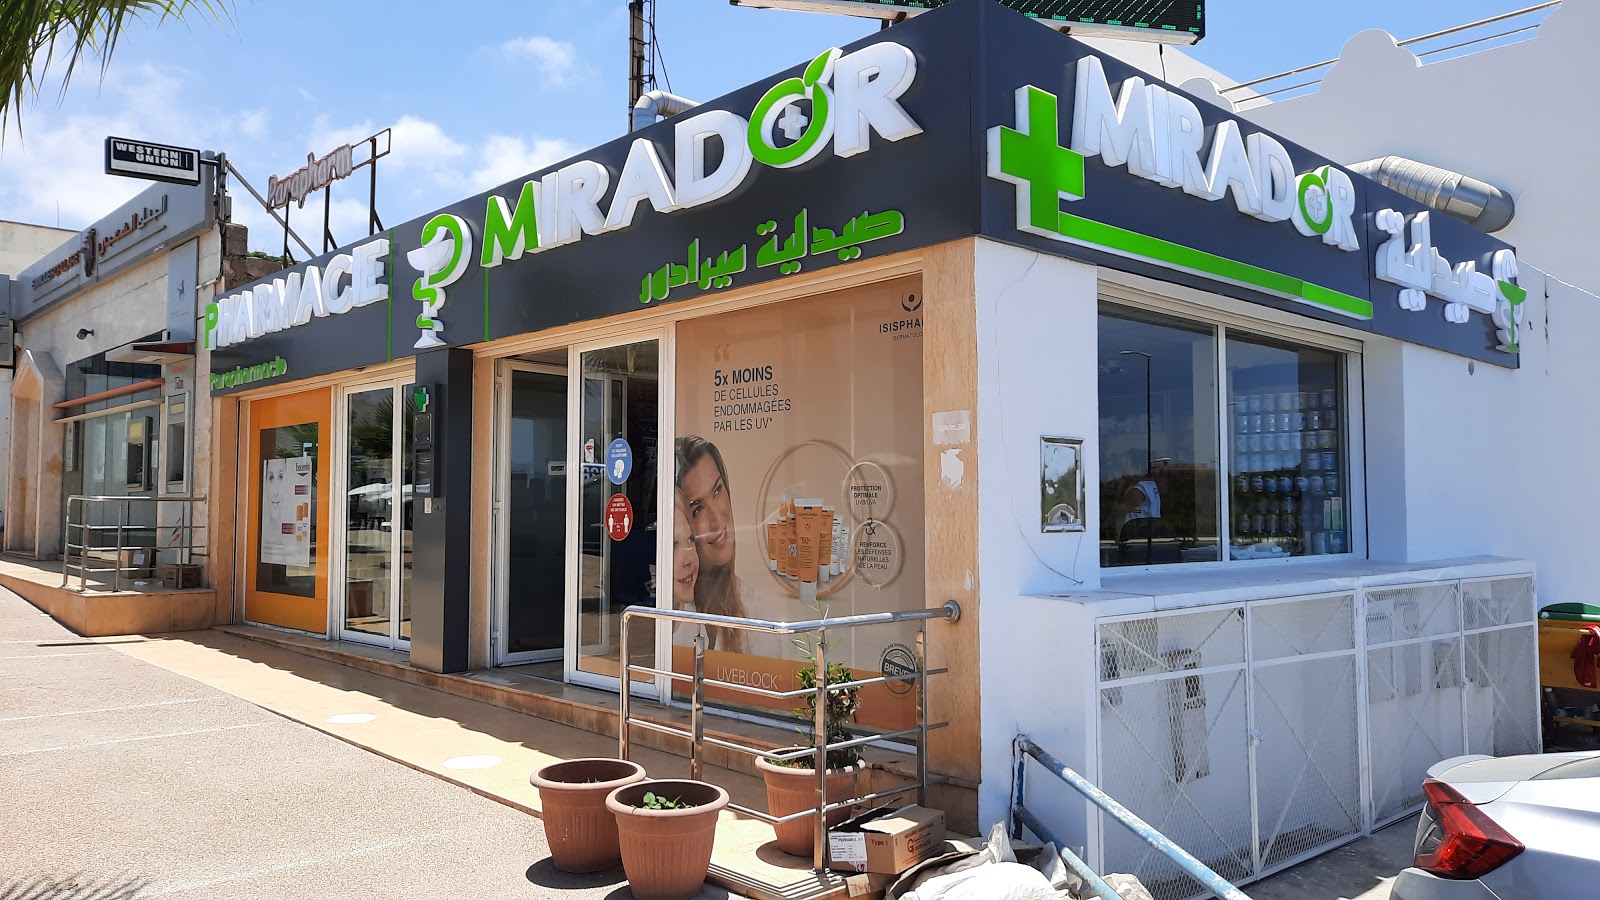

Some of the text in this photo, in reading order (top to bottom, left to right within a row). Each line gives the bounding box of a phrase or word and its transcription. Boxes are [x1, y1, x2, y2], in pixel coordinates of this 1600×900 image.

[115, 142, 179, 160] WESTERN
[135, 153, 179, 167] UNION
[480, 41, 924, 268] MIRADOR
[1071, 54, 1360, 252] MIRADOR
[267, 143, 353, 213] Parapharm
[639, 208, 905, 304] صيدلية ميرادور
[1375, 208, 1497, 324] صيدلية
[204, 238, 390, 351] PHARMACIE
[209, 355, 288, 391] Parapharmacie
[714, 365, 773, 387] 5x MOINS
[714, 384, 779, 402] DE CELLULES
[714, 397, 791, 417] ENDOMMAGÉES
[713, 420, 732, 432] PAR
[734, 418, 753, 431] LES
[295, 462, 310, 472] Eucerin
[857, 555, 889, 563] NATURELLES
[874, 562, 888, 570] PEAU
[716, 666, 779, 690] UVEBLOCK
[870, 838, 885, 846] Type
